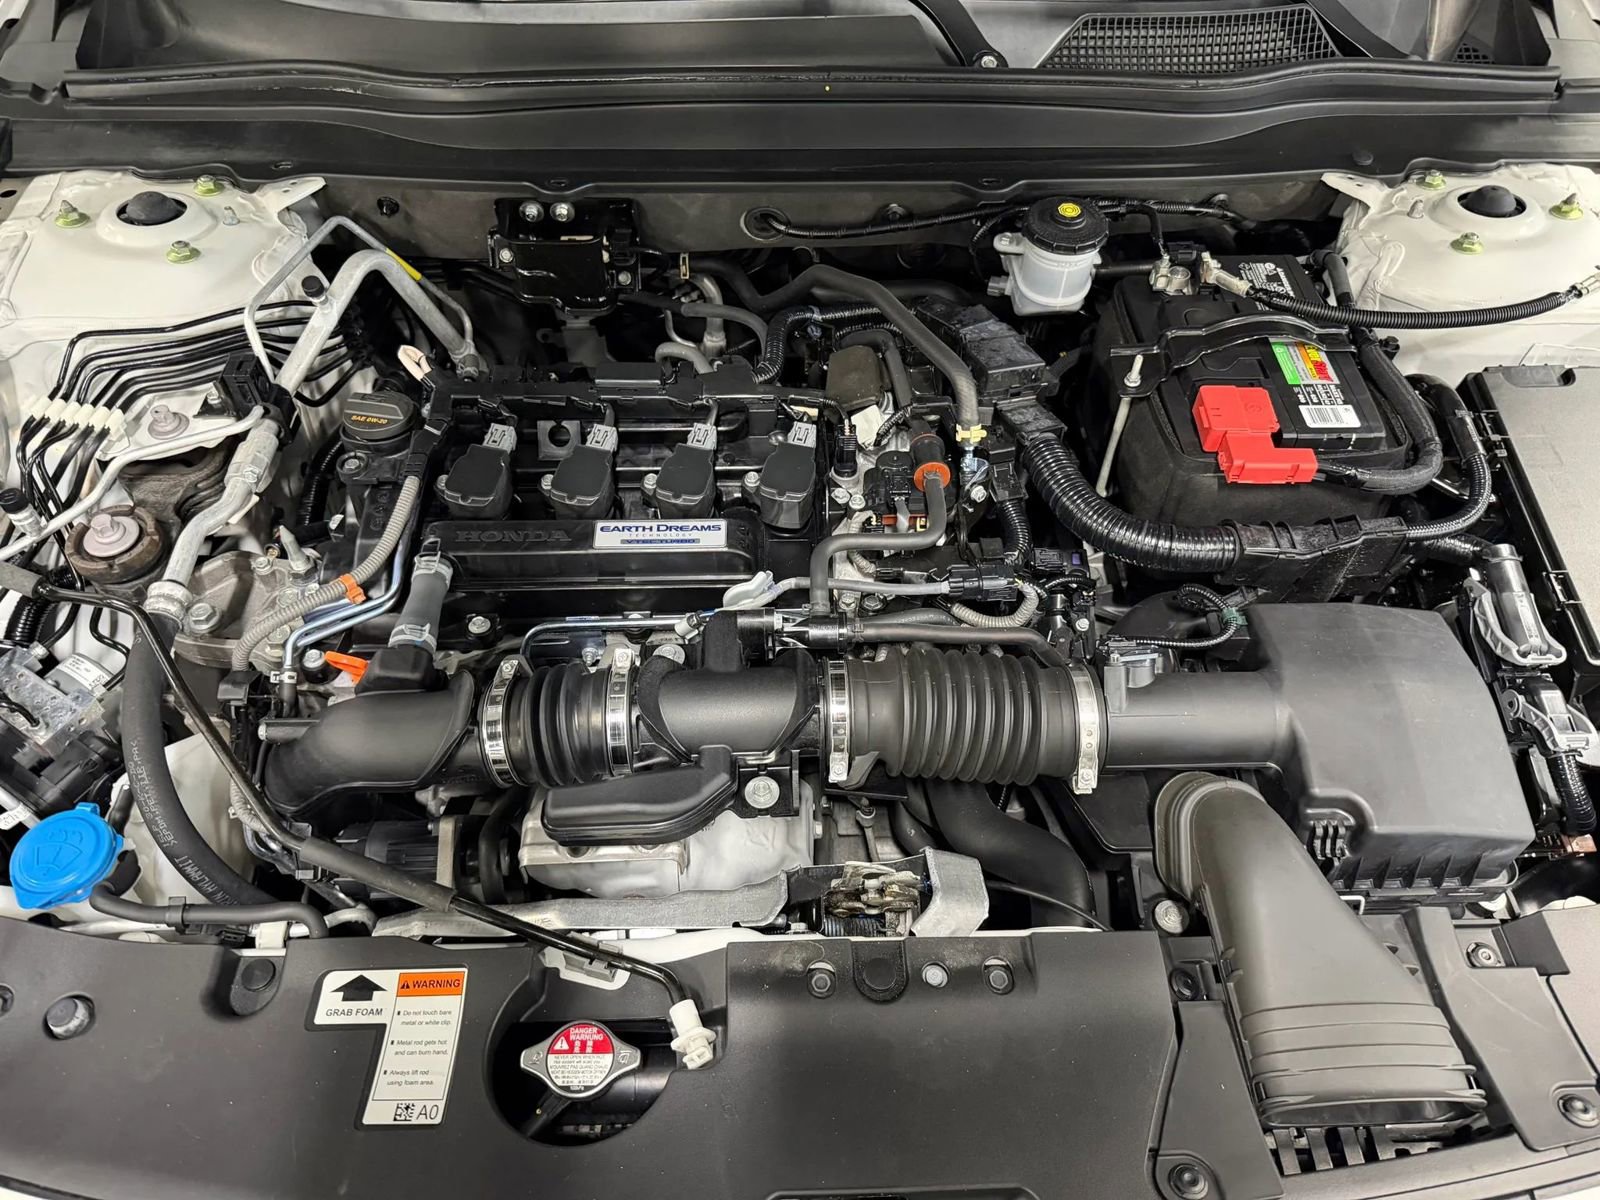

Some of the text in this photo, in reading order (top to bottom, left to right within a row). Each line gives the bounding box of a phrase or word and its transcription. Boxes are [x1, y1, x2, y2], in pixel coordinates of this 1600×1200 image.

[366, 417, 388, 425] 0W-20
[600, 524, 722, 533] EARTH DREAMS
[455, 530, 572, 542] HONDA
[412, 979, 461, 989] WARNING
[325, 1008, 383, 1017] GRAB FOAM
[570, 1033, 604, 1041] WARNUNG
[389, 1069, 411, 1077] Always
[416, 1104, 439, 1120] A0
